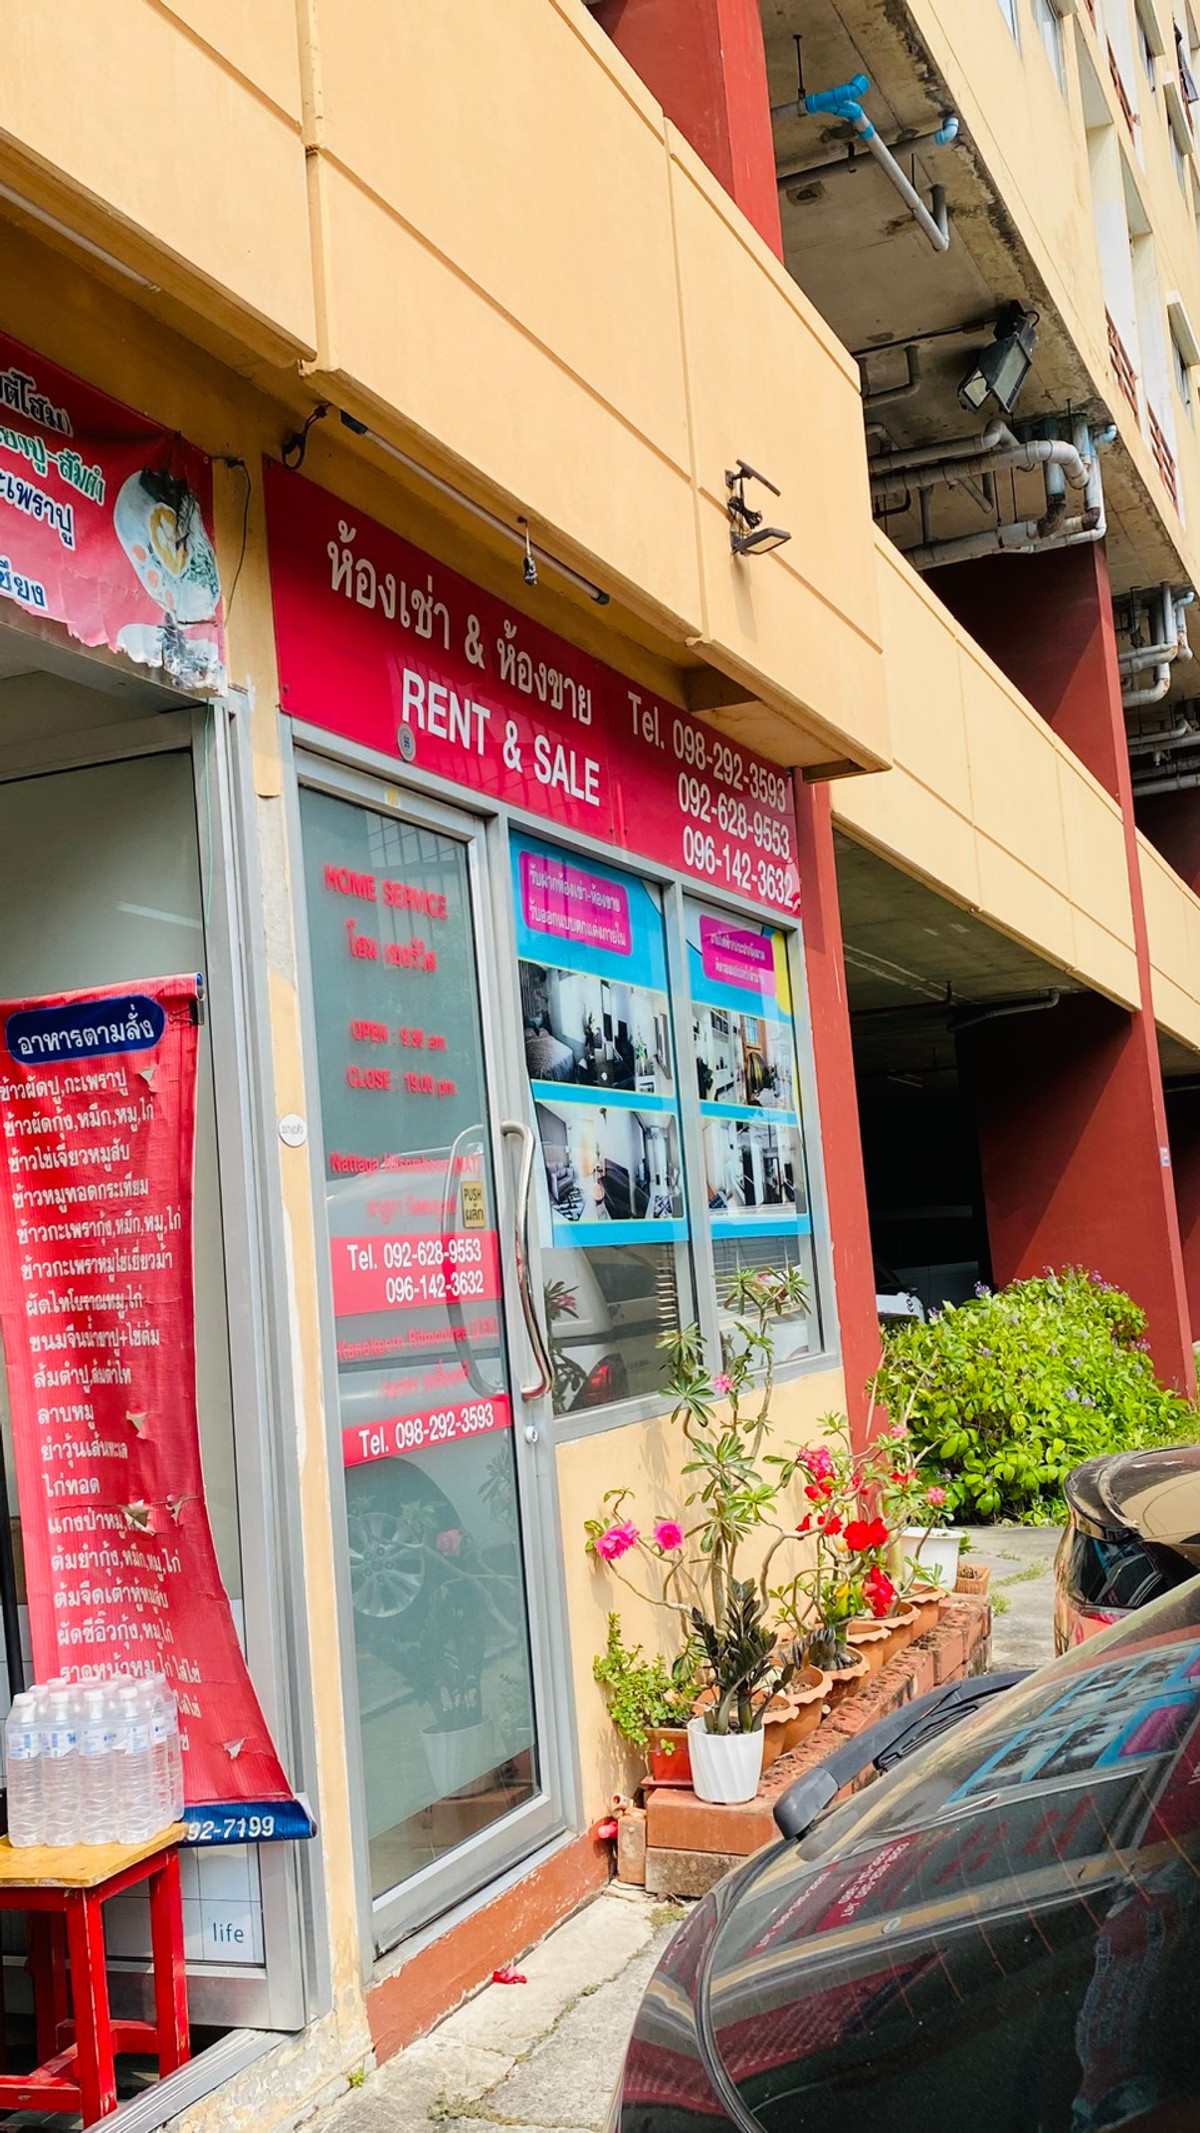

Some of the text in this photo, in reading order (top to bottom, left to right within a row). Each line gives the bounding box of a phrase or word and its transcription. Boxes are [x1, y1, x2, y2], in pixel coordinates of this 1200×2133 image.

[327, 519, 592, 726] ห้องเช่า & ห้องขาย
[402, 667, 600, 807] RENT & SALE
[627, 690, 786, 814] Tel. 098-292-3593
[678, 771, 790, 861] 092-628-9553
[682, 825, 794, 909] 096-142-3632
[324, 863, 449, 921] HOME SERVICE
[18, 1004, 155, 1056] อาหารตามสั่ง
[351, 1019, 390, 1044] OPEN
[0, 1067, 129, 1105] ข้าวผัดปู,กะเพราปู
[346, 1065, 391, 1091] CLOSE
[4, 1097, 155, 1140] ข้าวผัดกุ้ง,หมึก,หมู,ไก่
[13, 1171, 149, 1214] ข้าวหมูทอดกระเทียม
[463, 1188, 482, 1202] PUSH
[347, 1238, 483, 1271] Tel. 092-628-9553
[386, 1270, 485, 1304] 096-142-3632
[37, 1404, 96, 1430] ลาบหมู
[358, 1402, 495, 1458] Tel. 098-292-3593
[42, 1472, 101, 1498] ไก่ทอด
[186, 1815, 275, 1841] 92-7199
[212, 1922, 245, 1944] life
